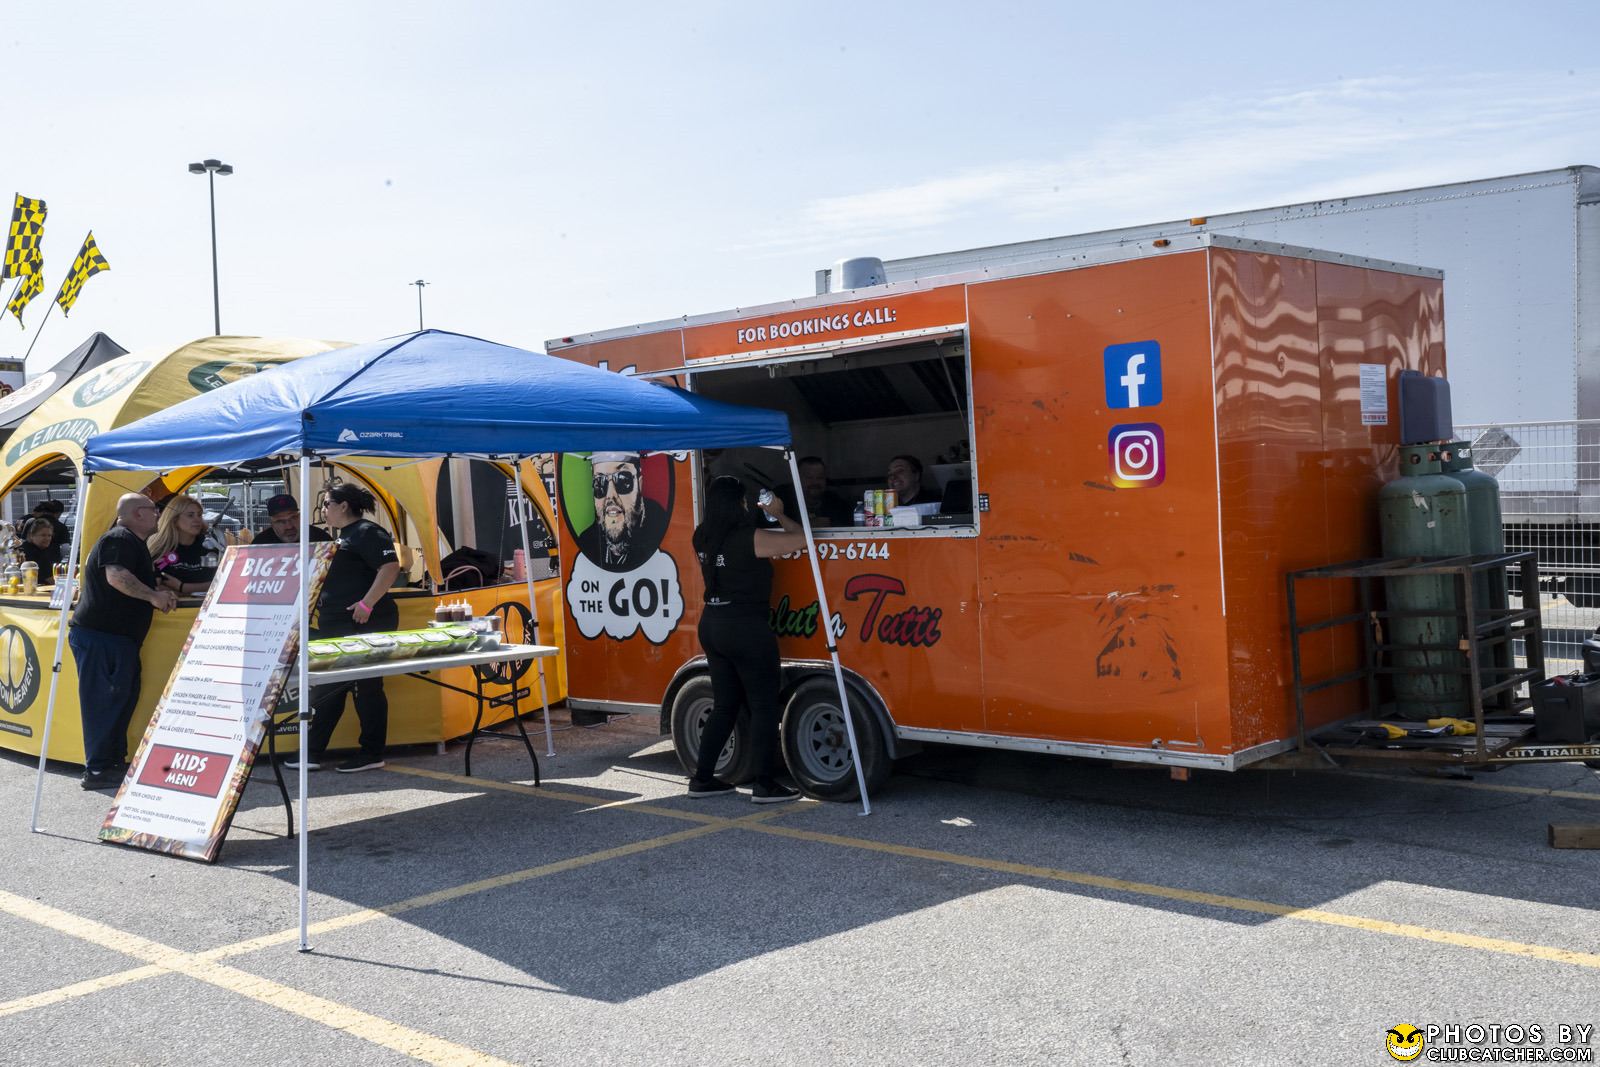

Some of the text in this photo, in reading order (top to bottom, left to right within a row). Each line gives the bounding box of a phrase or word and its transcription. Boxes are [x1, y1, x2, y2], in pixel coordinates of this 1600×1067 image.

[737, 307, 898, 344] FOR BOOKINGS CALL:
[19, 419, 98, 457] LEMONAD
[240, 557, 275, 577] BIG
[243, 579, 286, 594] MENU
[580, 580, 600, 593] ON
[579, 577, 669, 618] THE GO!
[845, 573, 942, 648] Tutti
[13, 660, 34, 705] HEAVEN
[171, 752, 208, 773] KIDS
[1505, 749, 1536, 758] CITY
[164, 772, 199, 788] MENU
